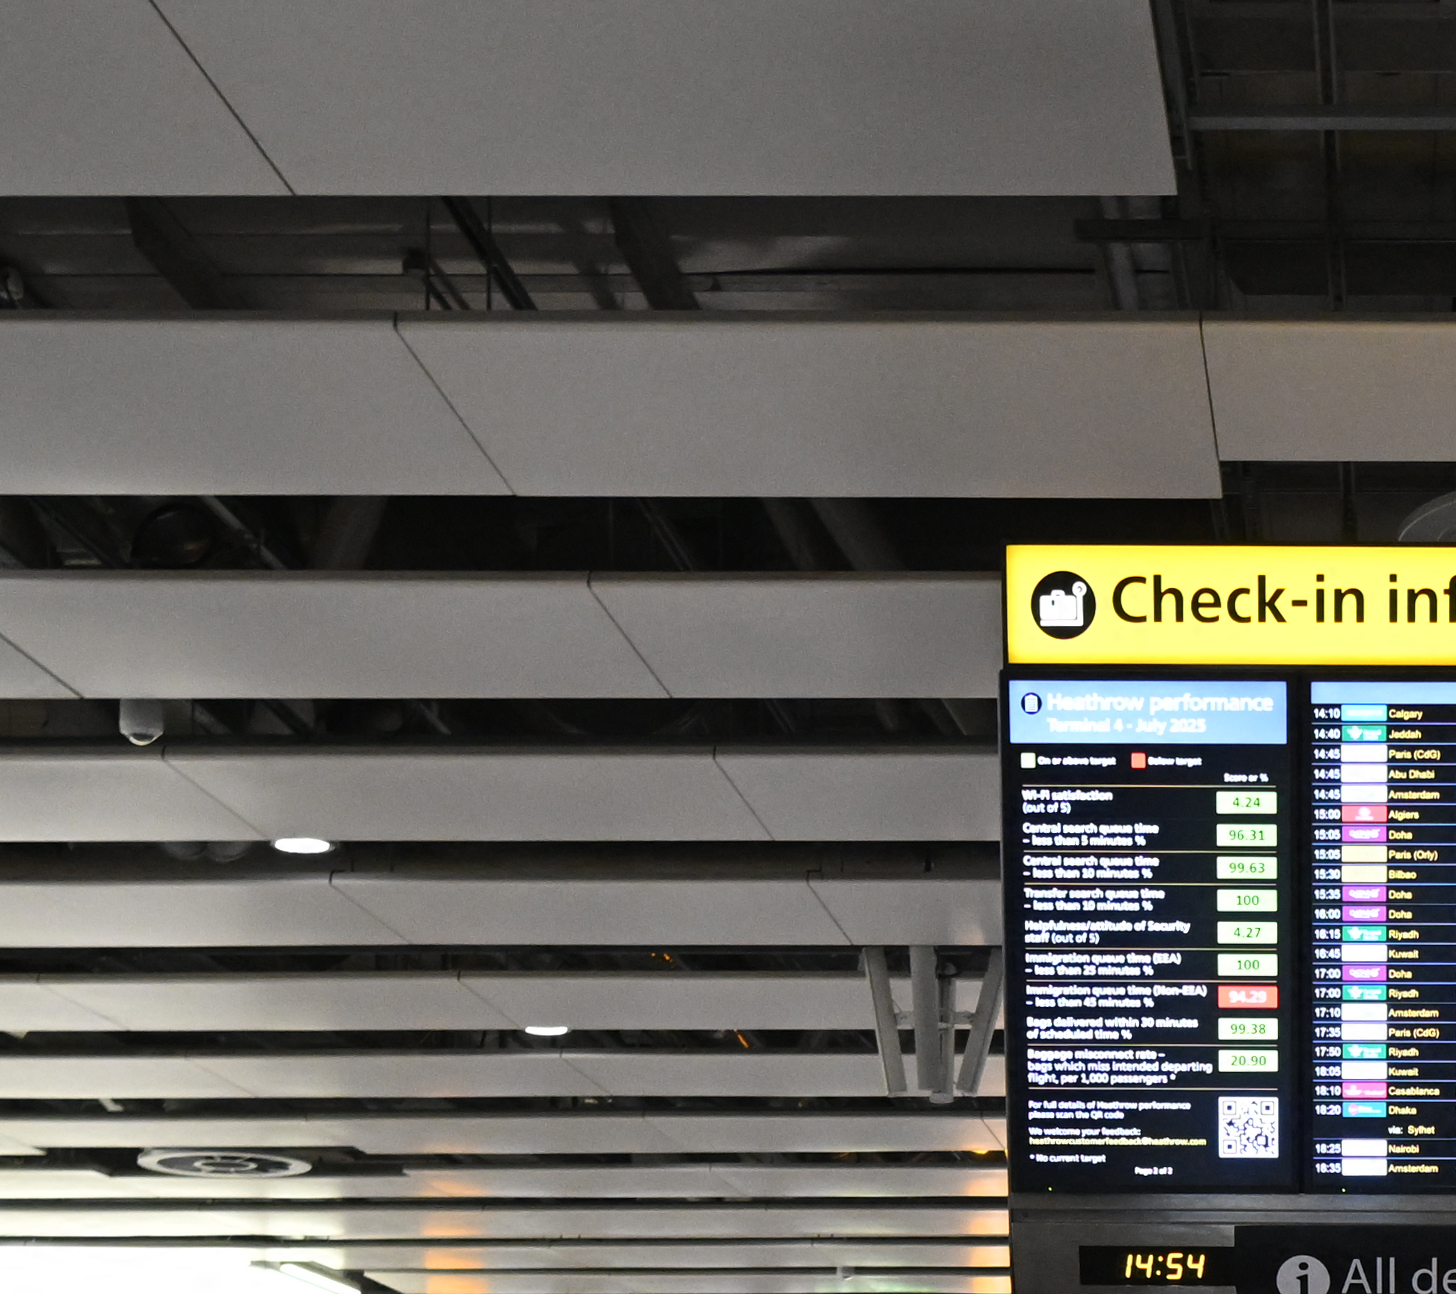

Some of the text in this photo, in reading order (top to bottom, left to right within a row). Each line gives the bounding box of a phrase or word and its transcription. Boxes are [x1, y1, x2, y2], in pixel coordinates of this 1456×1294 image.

[1113, 574, 1364, 623] Check-in
[1048, 693, 1273, 715] Heathrow performance
[1047, 718, 1110, 732] Terminal
[1232, 797, 1261, 808] 4.24
[1229, 829, 1265, 841] 96.31
[1229, 862, 1265, 874] 99.63
[1236, 895, 1260, 906] 100
[1233, 927, 1261, 939] 4.27
[1237, 959, 1260, 971] 100
[1230, 1023, 1266, 1035] 99.38
[1231, 1055, 1267, 1067] 20.90
[1125, 1253, 1205, 1280] 14:54
[1342, 1257, 1395, 1294] All
